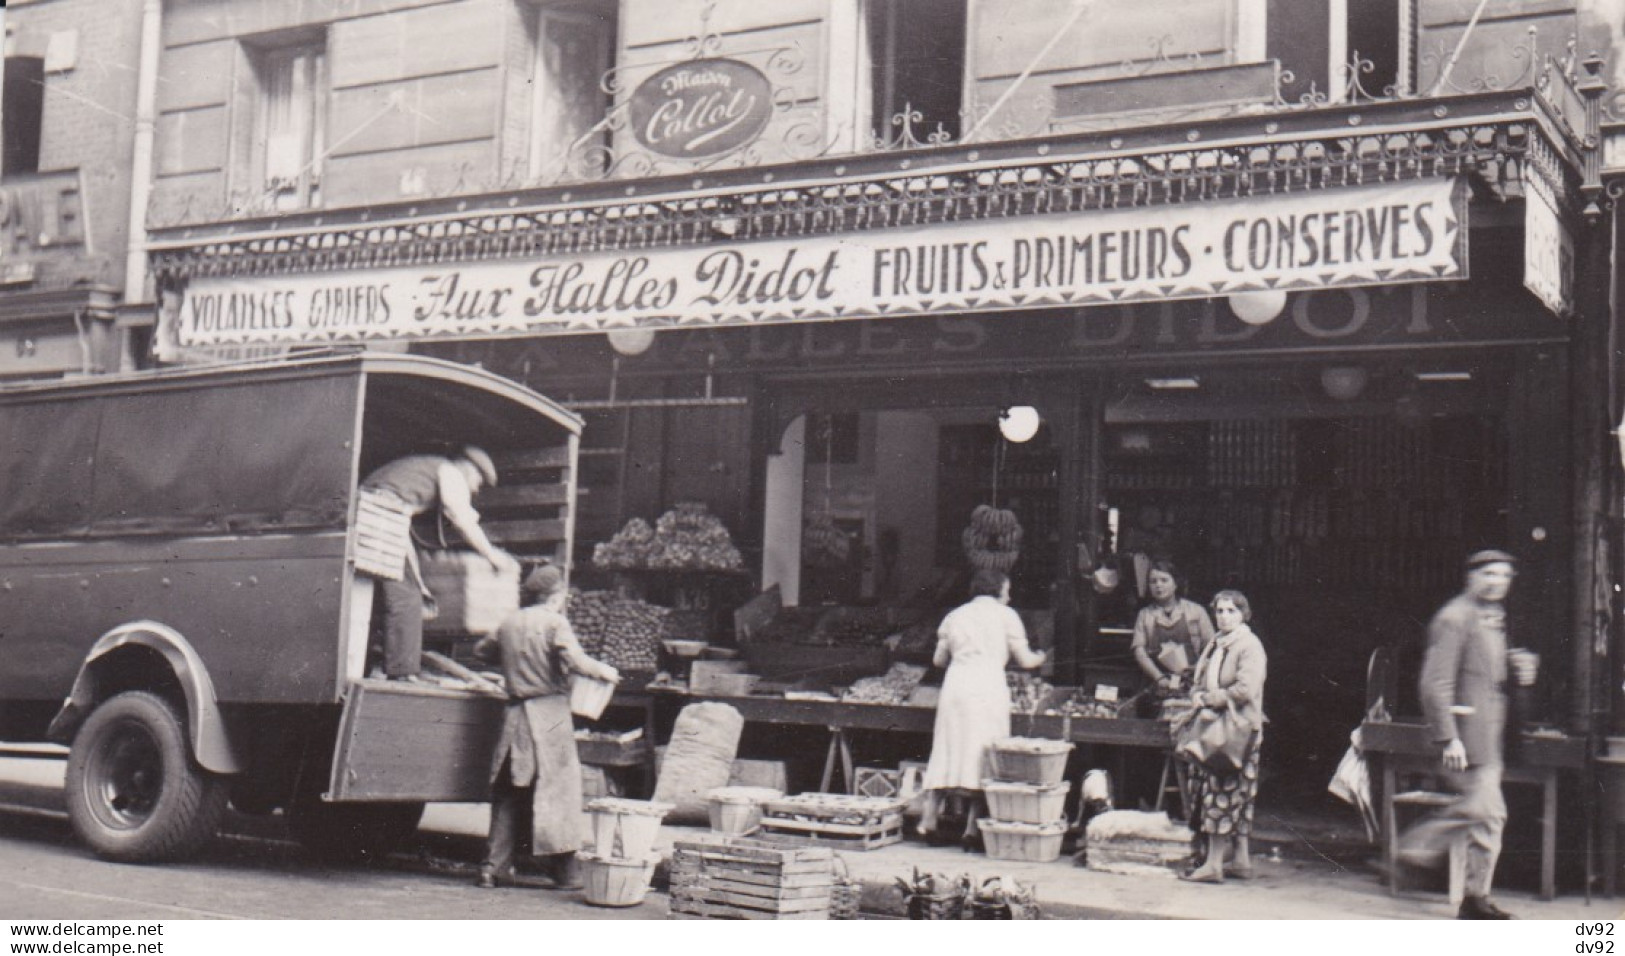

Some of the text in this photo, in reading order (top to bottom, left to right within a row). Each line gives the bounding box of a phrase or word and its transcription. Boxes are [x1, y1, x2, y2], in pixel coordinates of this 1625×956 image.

[661, 69, 732, 96] Maison
[645, 88, 756, 150] Collot
[190, 201, 1435, 332] VOLAILLES GIBIERS Aux Halles Didot FRUITS & PRIMEURS CONSERVES
